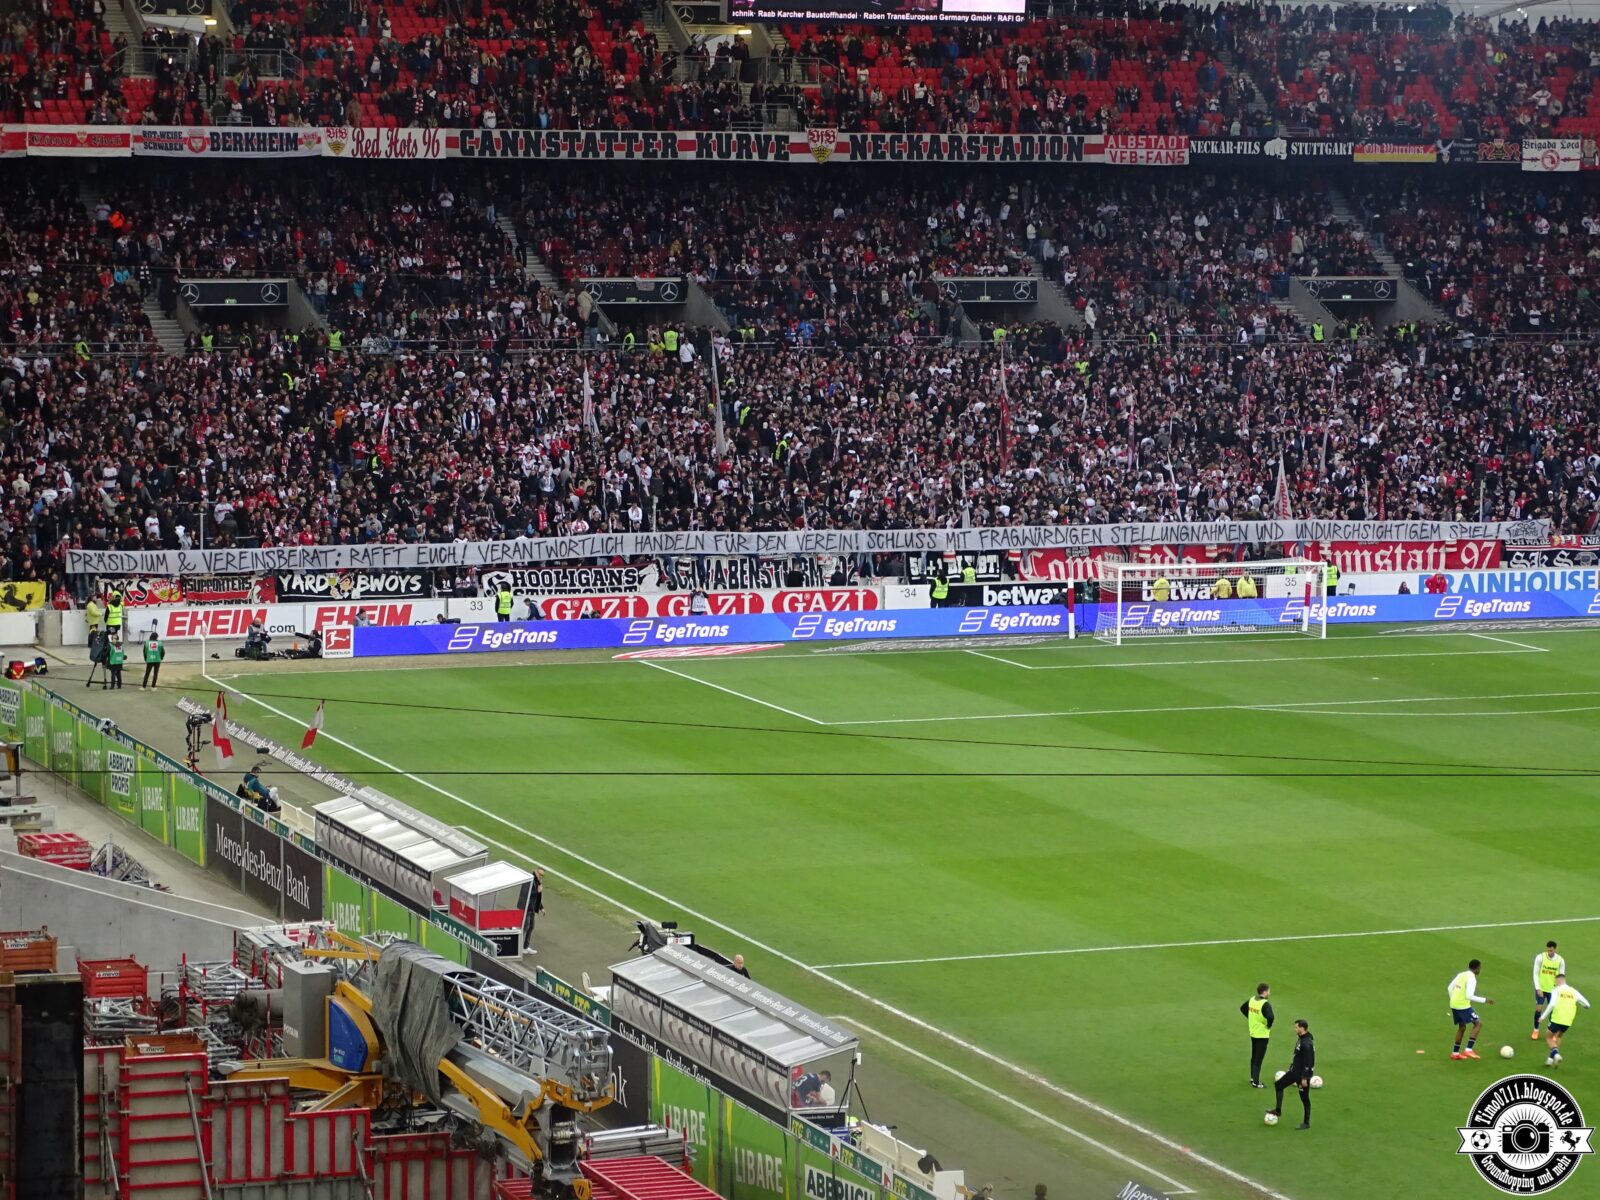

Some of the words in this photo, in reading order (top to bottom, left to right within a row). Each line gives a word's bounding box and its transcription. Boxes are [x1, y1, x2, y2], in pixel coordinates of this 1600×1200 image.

[806, 11, 857, 20] Baustoffhandel
[863, 12, 885, 20] Raben
[887, 13, 937, 22] TransEuropean
[940, 14, 969, 22] Germany
[143, 142, 183, 151] SCHWABEN
[209, 132, 299, 152] BERKHEIM
[351, 128, 382, 158] Red
[385, 128, 418, 158] Hots
[422, 128, 440, 158] 96
[459, 130, 678, 158] CANNSTATTER
[695, 131, 790, 161] KURVE
[849, 134, 1085, 162] NECKARSTADION
[1107, 136, 1188, 149] ALBSTADT
[1190, 141, 1261, 155] NECKAR-FILS
[1291, 142, 1354, 155] STUTTGART
[1522, 140, 1557, 151] Brigada
[1560, 140, 1580, 150] Loca
[1108, 150, 1185, 164] VFB-FANS
[68, 551, 169, 573] PRÄSIDIUM
[178, 553, 197, 573] &
[202, 547, 342, 571] VEREINSBEIRAT:
[351, 544, 408, 566] RAFFT
[417, 543, 466, 565] EUCH!
[480, 535, 624, 564] VERANTWORTLICH
[635, 533, 704, 555] HANDELN
[715, 532, 750, 552] FÜR
[755, 532, 787, 553] DEN
[796, 531, 860, 551] VEREIN!
[867, 530, 936, 550] SCHLUSS
[946, 530, 970, 549] MIT
[980, 524, 1102, 548] FRAGWÜRDIGEN
[1110, 520, 1248, 544] STELLUNGNAHMEN
[1257, 522, 1285, 541] UND
[1296, 520, 1441, 541] UNDURCHSICHTIGEM
[1449, 521, 1502, 540] SPIEL!
[1460, 541, 1496, 570] 97
[186, 576, 252, 593] SUPPORTERS
[279, 573, 329, 593] YARD
[357, 573, 422, 593] BWOYS
[511, 568, 640, 588] HOOLIGANS
[1285, 577, 1297, 587] 35
[470, 601, 484, 611] 33
[1310, 602, 1377, 619] EgeTrans
[1464, 597, 1531, 617] EgeTrans
[166, 608, 268, 638] EHEIM
[824, 617, 897, 637] EgeTrans
[990, 613, 1061, 633] EgeTrans
[1152, 607, 1221, 627] EgeTrans
[481, 627, 558, 649] EgeTrans
[655, 622, 729, 644] EgeTrans
[109, 751, 135, 775] ABBRUCH
[112, 774, 130, 795] PROFIS
[142, 786, 163, 812] LIBARE
[176, 805, 200, 832] LIBARE
[215, 823, 282, 892] Mercedes-Benz
[286, 864, 311, 910] Bank
[332, 901, 361, 934] LIBARE
[735, 1147, 784, 1194] LIBARE
